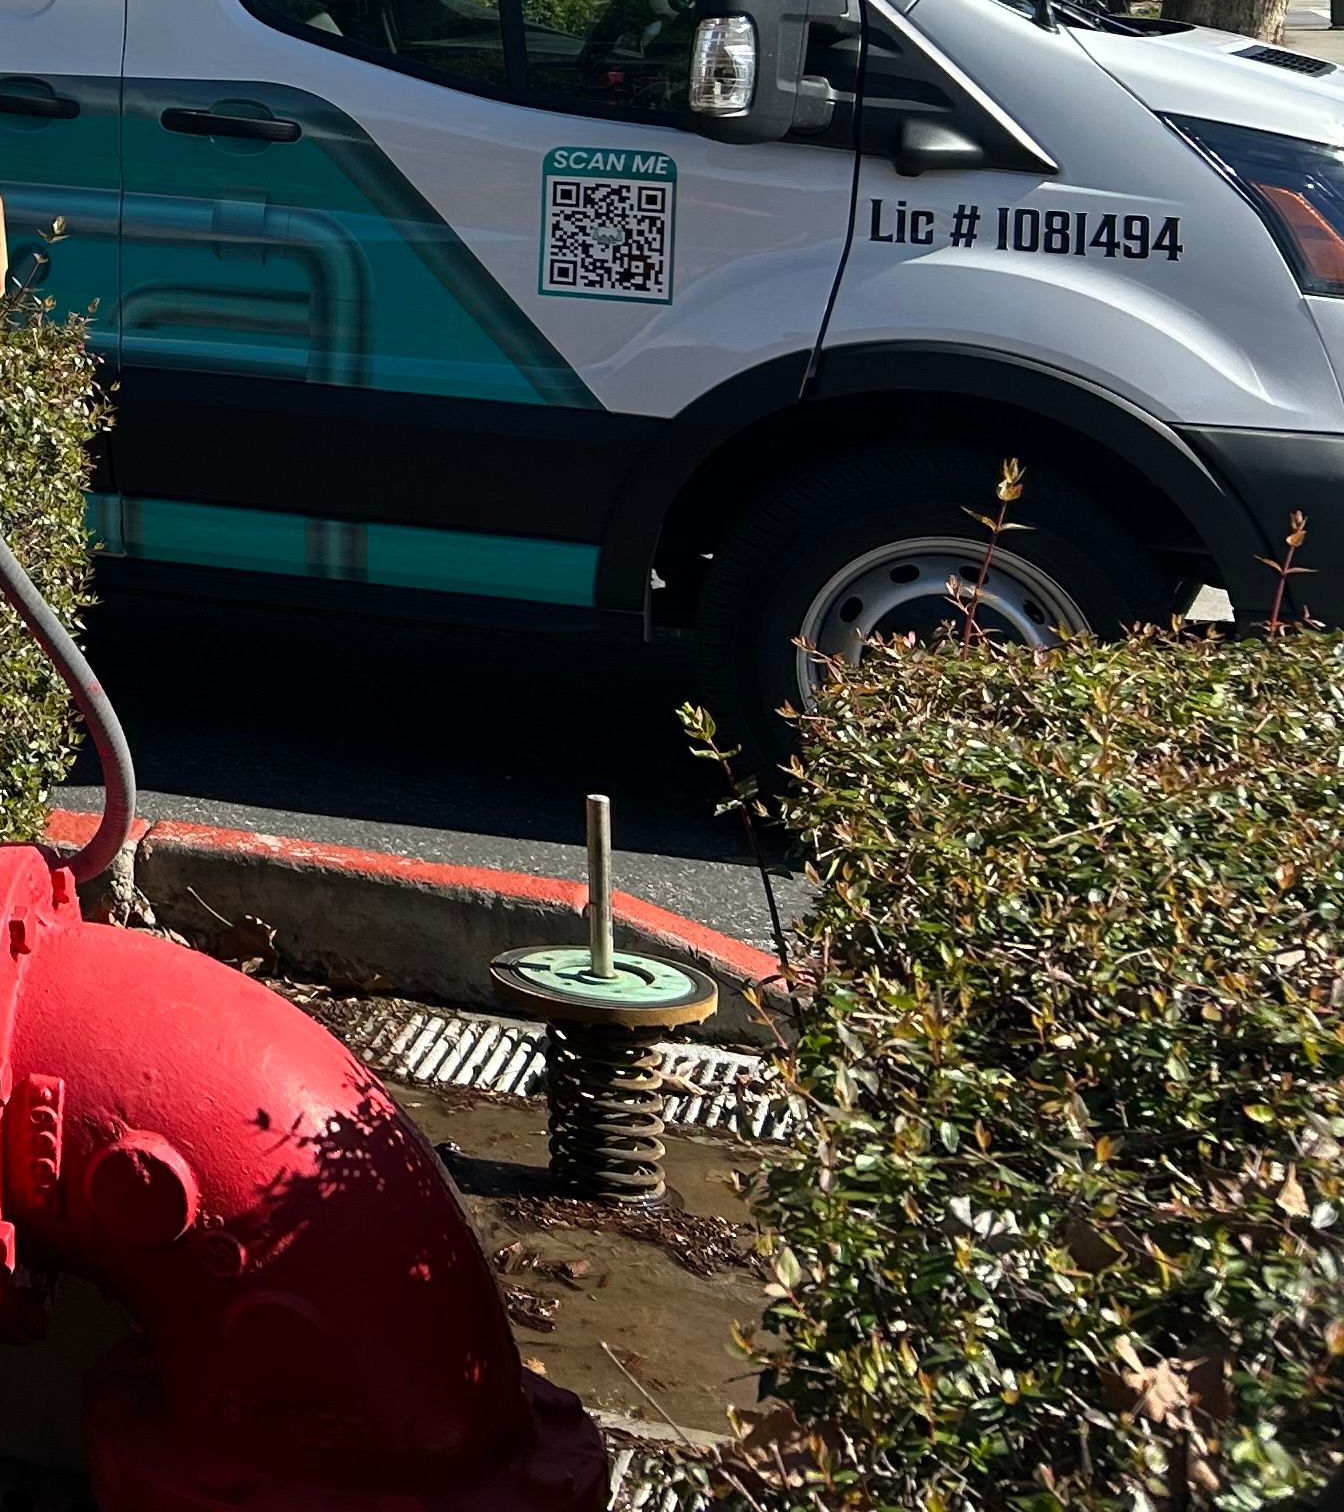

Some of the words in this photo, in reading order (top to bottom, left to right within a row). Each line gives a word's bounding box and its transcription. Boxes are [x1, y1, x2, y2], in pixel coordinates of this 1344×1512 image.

[553, 150, 626, 172] SCAN
[632, 154, 670, 175] ME
[869, 198, 935, 245] Lic
[949, 204, 981, 248] #
[996, 207, 1184, 262] 1081494
